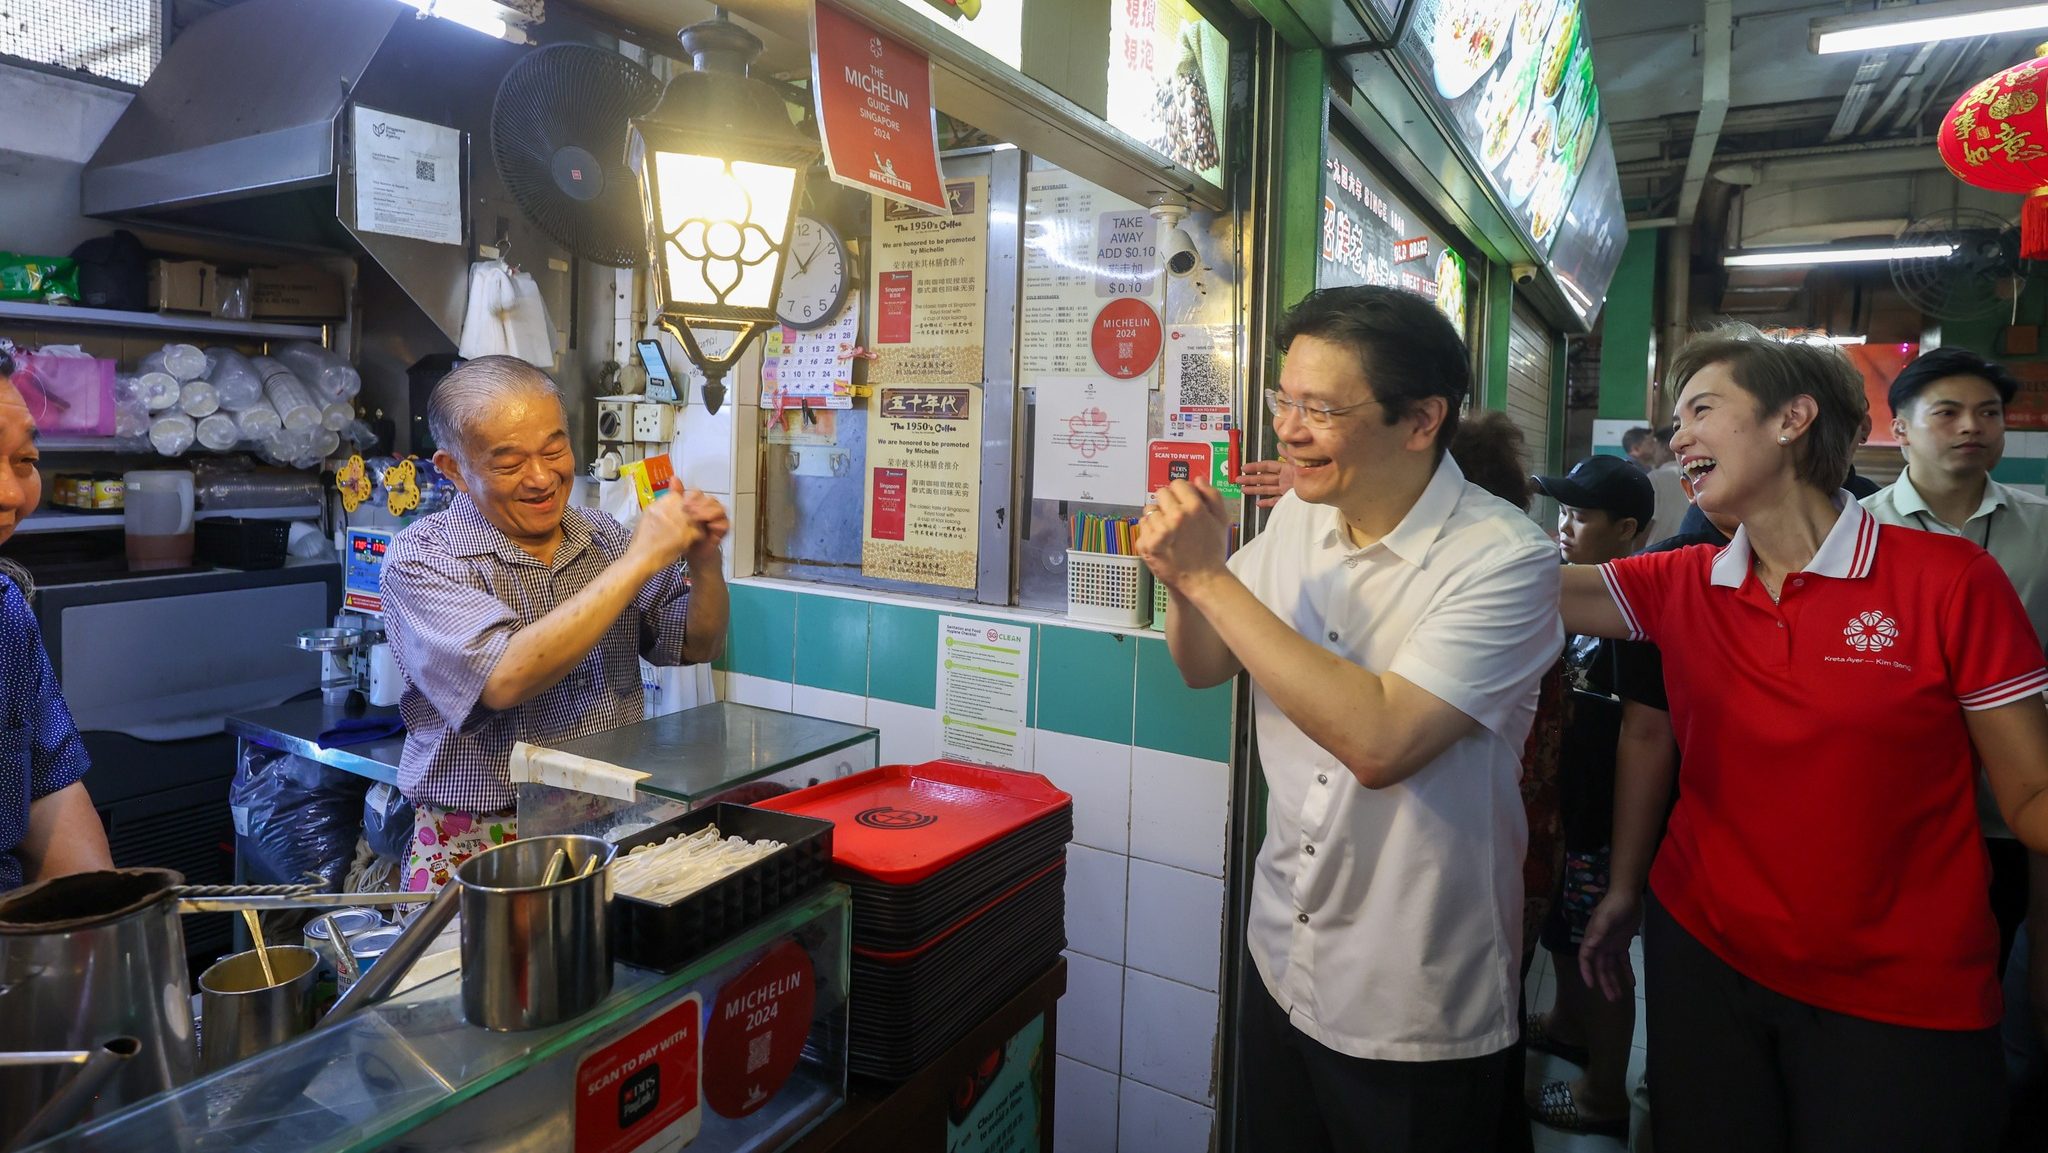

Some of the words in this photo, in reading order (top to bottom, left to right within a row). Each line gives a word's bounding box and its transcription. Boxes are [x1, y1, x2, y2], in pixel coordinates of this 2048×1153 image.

[870, 65, 884, 79] THE
[845, 66, 908, 109] MICHELIN
[868, 96, 891, 114] GUIDE
[860, 108, 900, 132] SINGAPORE
[874, 126, 890, 140] 2024
[869, 171, 912, 191] MICHELIN
[1364, 186, 1387, 222] SINCE
[910, 221, 938, 231] 1950's
[1112, 217, 1143, 228] TAKE
[796, 224, 810, 236] 12
[946, 236, 976, 245] promoted
[1110, 232, 1144, 244] AWAY
[828, 242, 836, 254] 2
[1098, 248, 1122, 258] ADD
[1125, 246, 1156, 258] $0.10
[1394, 244, 1406, 261] OLD
[834, 263, 841, 275] 3
[1402, 272, 1420, 291] GREAT
[830, 284, 837, 294] 4
[788, 300, 795, 312] 7
[803, 305, 812, 317] 6
[819, 299, 827, 312] 5
[1103, 318, 1150, 328] MICHELIN
[1116, 329, 1136, 338] 2024
[888, 394, 958, 414] 五十年代
[906, 422, 933, 431] 1950's
[999, 634, 1021, 642] CLEAN
[725, 972, 800, 1020] MICHELIN
[746, 1002, 778, 1032] 2024
[588, 1069, 620, 1096] SCAN
[622, 1058, 636, 1074] TO
[638, 1045, 658, 1065] PAY
[660, 1027, 688, 1052] WITH
[978, 1110, 994, 1129] Clear
[1009, 1081, 1024, 1098] table
[980, 1131, 987, 1141] to
